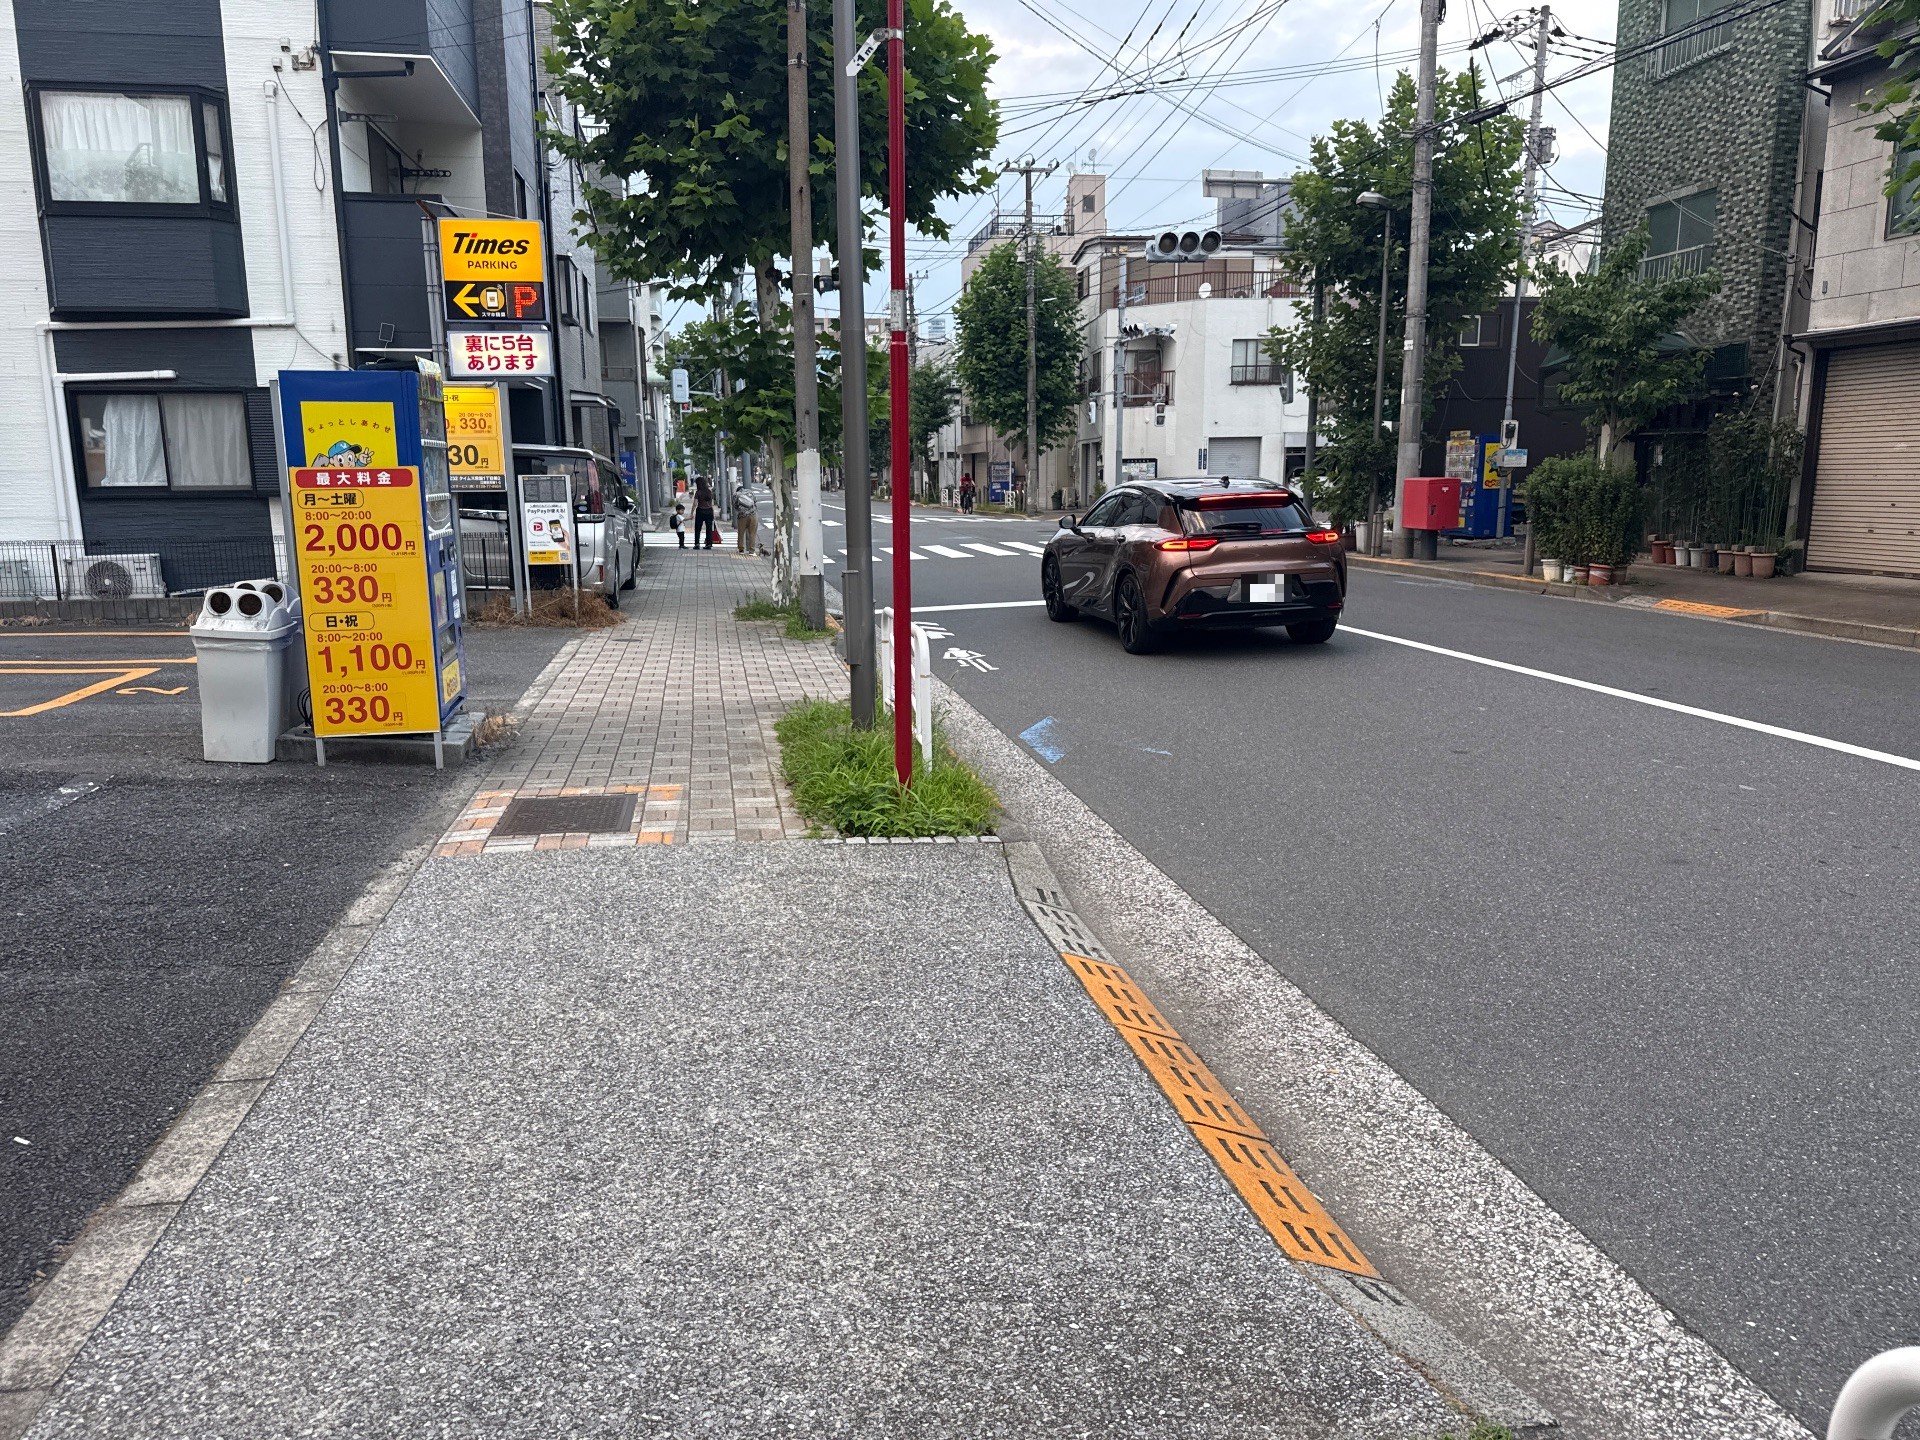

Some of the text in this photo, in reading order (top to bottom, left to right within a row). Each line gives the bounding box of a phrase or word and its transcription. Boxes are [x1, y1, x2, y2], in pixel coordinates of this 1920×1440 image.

[452, 232, 530, 255] Times
[467, 260, 518, 270] PARKING
[513, 286, 538, 318] P
[464, 334, 534, 352] 裏に5台
[467, 354, 538, 371] あります
[307, 418, 391, 434] ちょっとしあわせ
[316, 471, 392, 486] 最大料金
[304, 492, 358, 506] 月〜土曜
[304, 510, 372, 521] 8:00〜20:00
[310, 563, 378, 574] 20:00〜8:00
[325, 614, 358, 628] 日・祝
[316, 631, 383, 643] 8:00〜20:00
[322, 682, 389, 694] 20:00〜8:00
